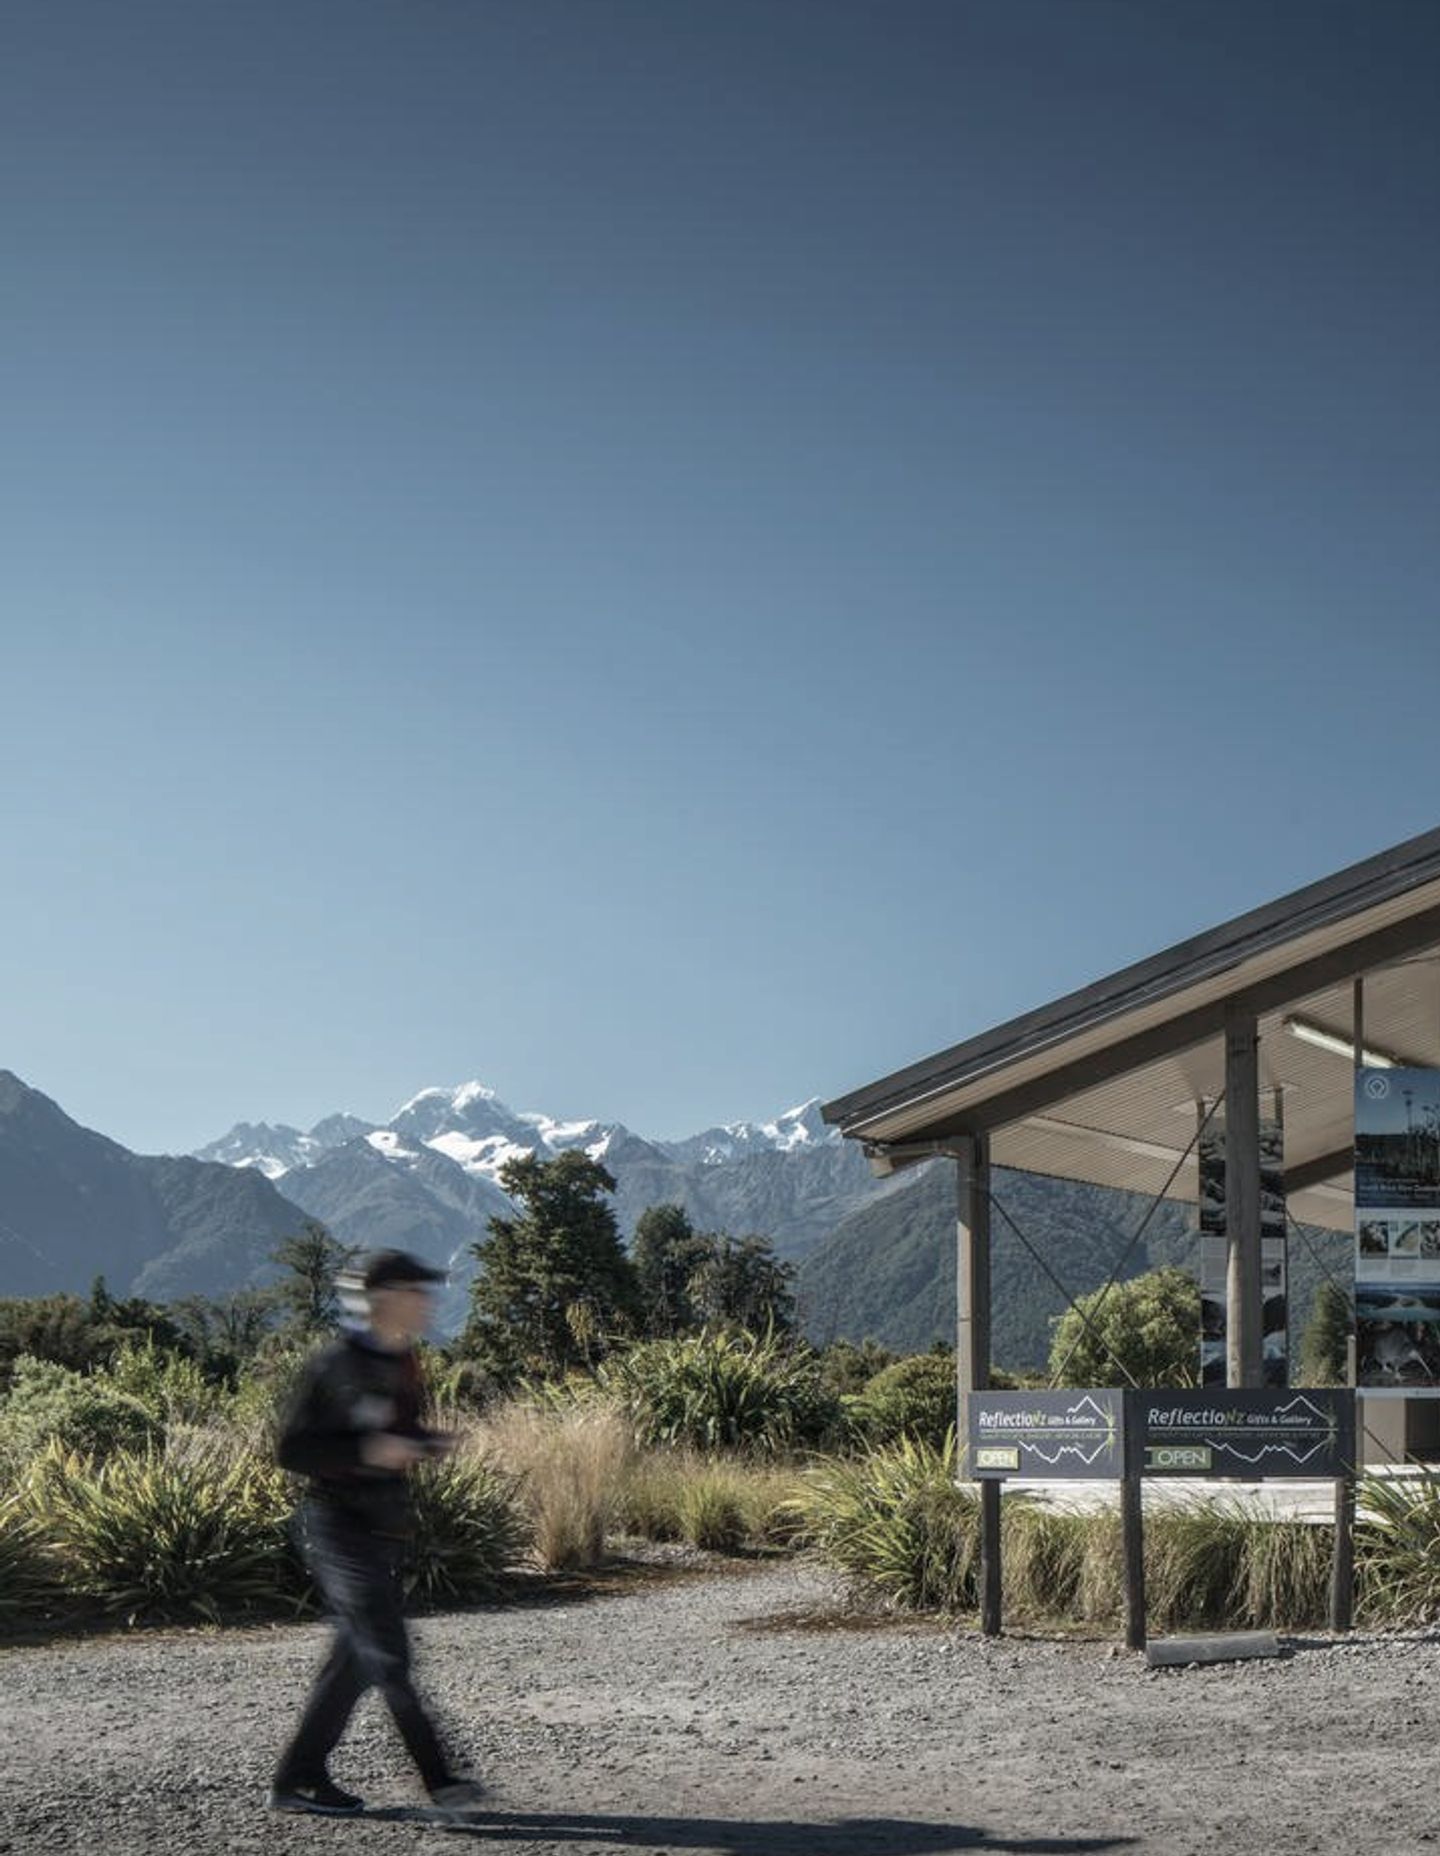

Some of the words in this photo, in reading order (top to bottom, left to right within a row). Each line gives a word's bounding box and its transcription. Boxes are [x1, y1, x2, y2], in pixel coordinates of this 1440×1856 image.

[1271, 1415, 1278, 1424] &
[1280, 1414, 1313, 1426] Gallery
[981, 1452, 1016, 1466] OPEN
[1157, 1449, 1207, 1466] OPEN
